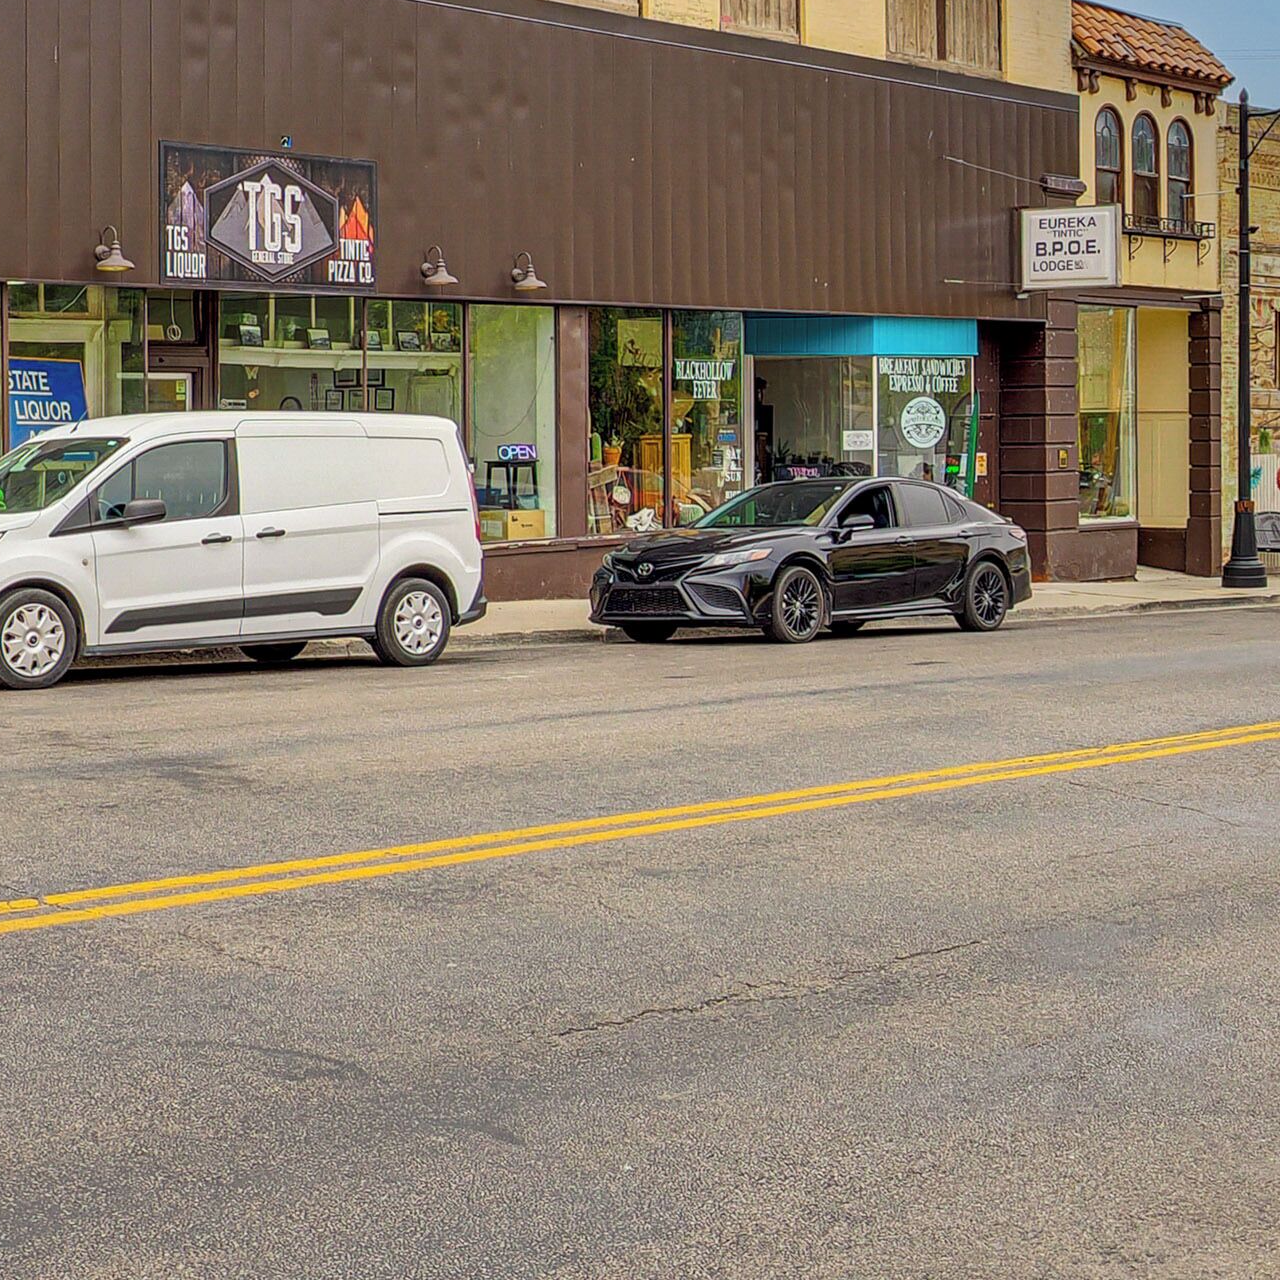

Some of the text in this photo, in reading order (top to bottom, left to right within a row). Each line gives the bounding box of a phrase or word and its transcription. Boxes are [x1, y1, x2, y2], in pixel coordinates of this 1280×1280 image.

[243, 181, 304, 252] TGS
[1039, 216, 1097, 229] EUREKA
[166, 225, 189, 251] TGS
[1035, 239, 1100, 256] B.P.O.E.
[251, 251, 294, 264] GENERAL STORE
[339, 239, 370, 261] TINTIC
[166, 252, 206, 278] LIQUOR
[328, 260, 375, 283] PIZZA CO.
[1033, 260, 1073, 272] LODGE
[675, 360, 735, 380] BLACKHOLLOW
[879, 358, 966, 377] BREAKFAST SANDWICHES
[8, 370, 50, 391] STATE
[693, 380, 718, 399] FEVER
[889, 375, 924, 392] ESPRESSO
[932, 376, 959, 393] COFFEE
[14, 400, 72, 421] LIQUOR
[498, 445, 537, 460] OPEN
[725, 471, 741, 482] SUN
